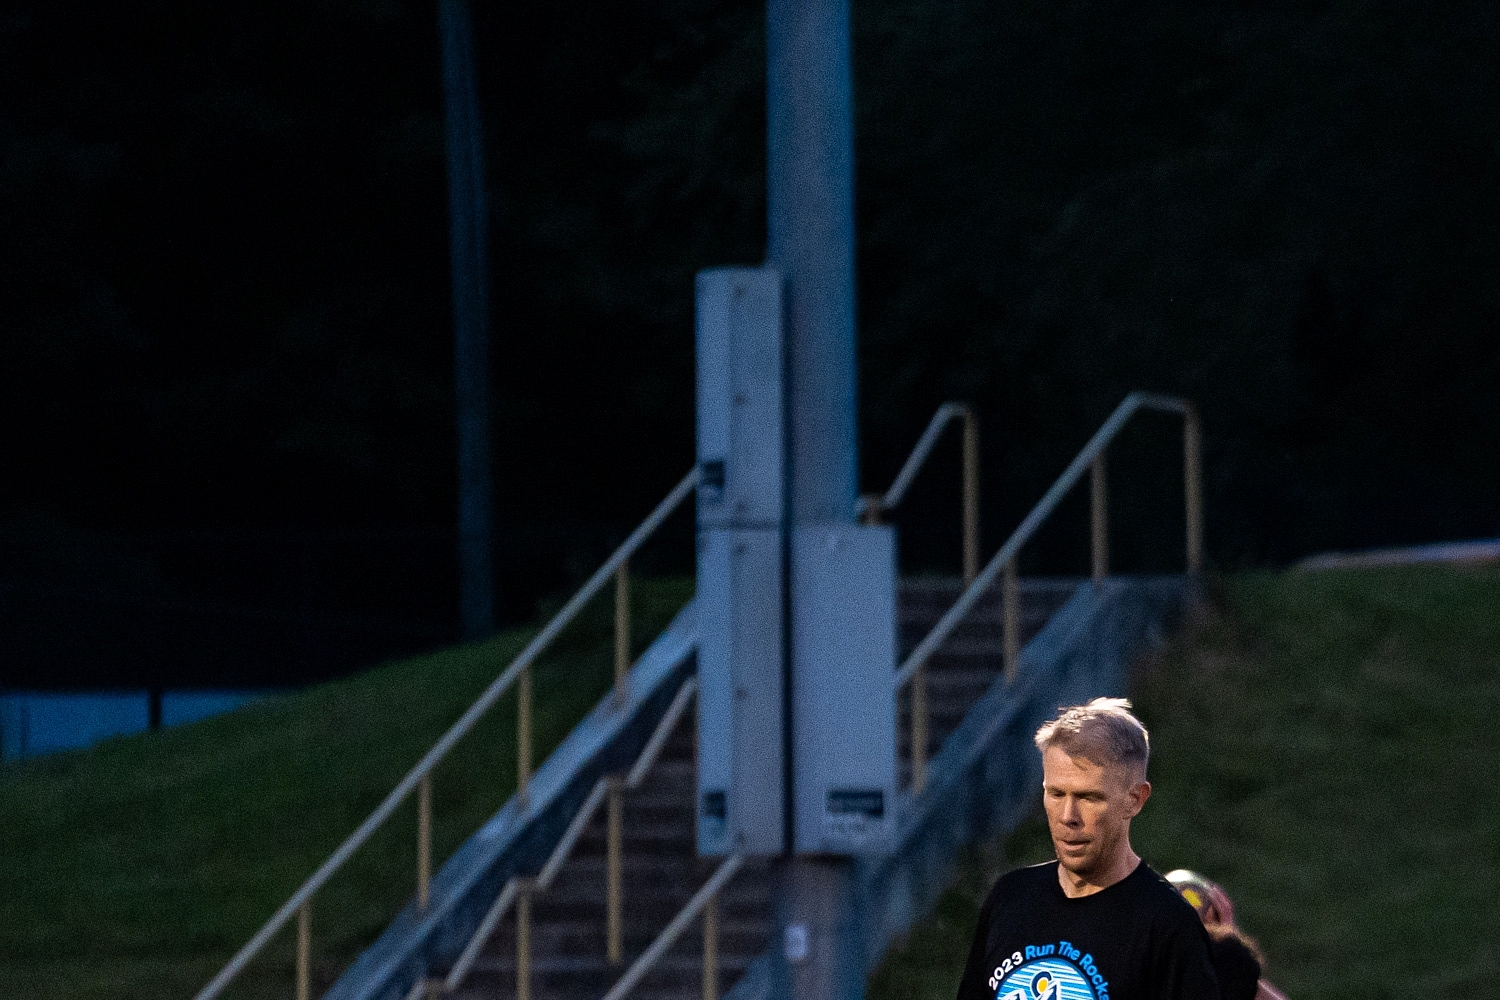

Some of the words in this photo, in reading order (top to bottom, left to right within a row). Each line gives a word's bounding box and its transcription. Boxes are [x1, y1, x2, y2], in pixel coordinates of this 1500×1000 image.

[988, 951, 1024, 991] 2023
[1025, 944, 1055, 961] Run
[1058, 940, 1081, 961] The
